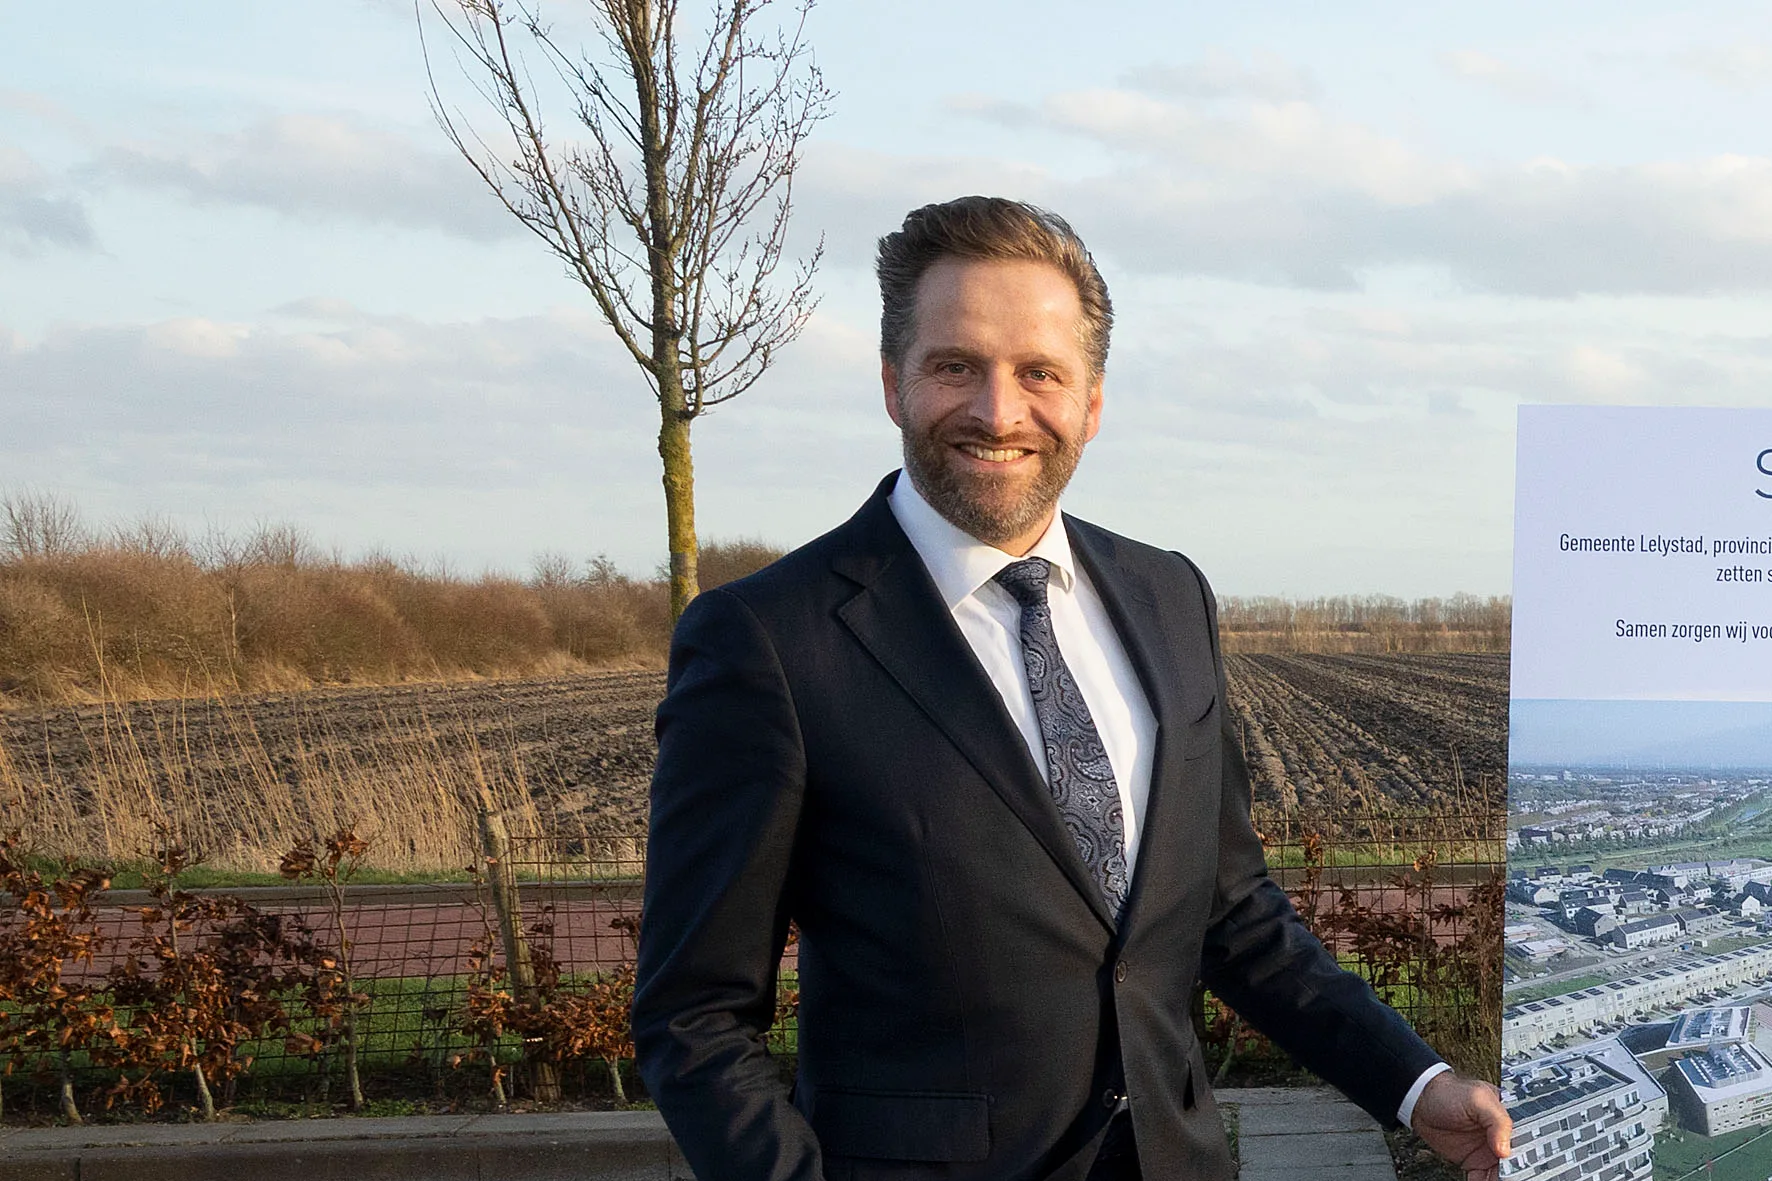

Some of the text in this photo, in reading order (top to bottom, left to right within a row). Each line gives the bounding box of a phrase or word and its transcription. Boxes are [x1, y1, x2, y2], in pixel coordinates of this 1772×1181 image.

[1559, 533, 1636, 553] Gemeente
[1640, 534, 1708, 558] Lelystad,
[1716, 565, 1763, 583] zetten
[1615, 618, 1667, 638] Samen
[1671, 624, 1721, 643] zorgen
[1725, 620, 1748, 644] wij
